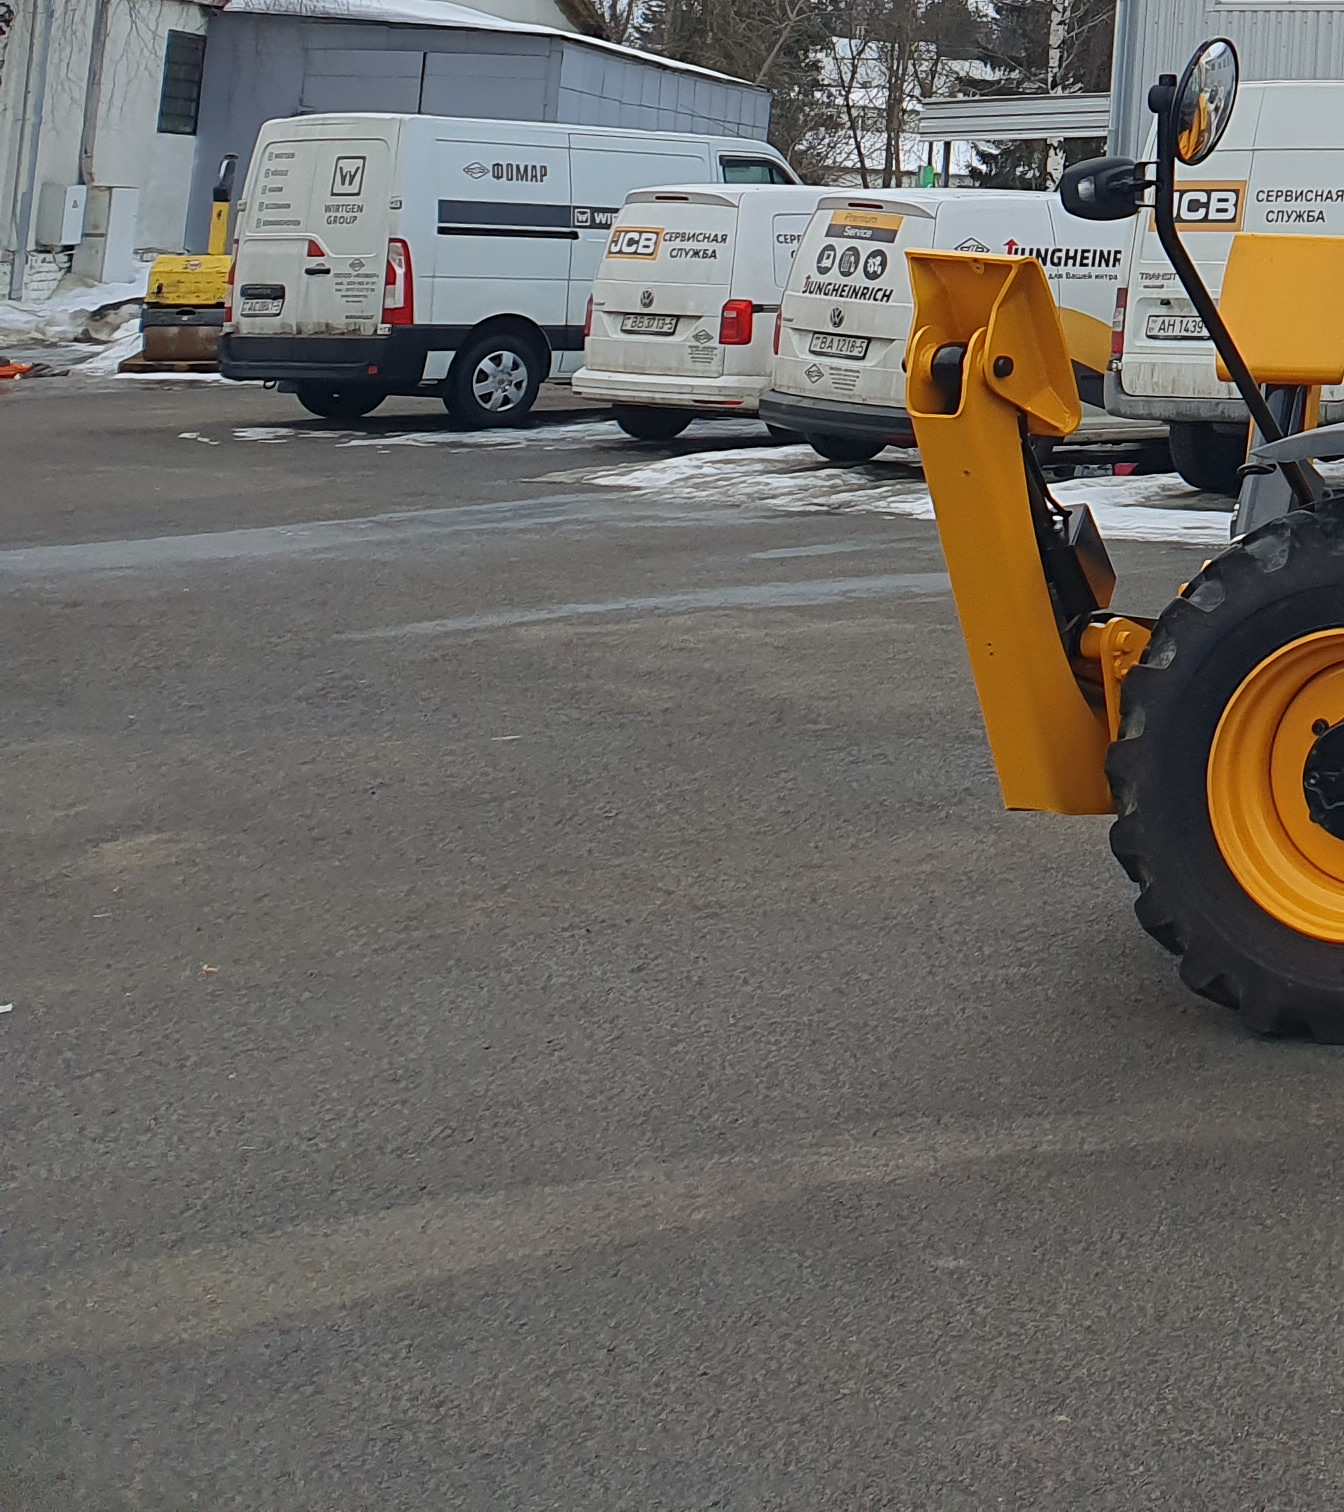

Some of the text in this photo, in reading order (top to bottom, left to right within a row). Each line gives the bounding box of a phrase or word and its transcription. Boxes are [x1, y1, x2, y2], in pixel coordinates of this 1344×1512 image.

[492, 162, 547, 183] ФОМАР
[1256, 189, 1344, 202] СЕРВИСНАЯ
[324, 204, 364, 213] WIRTGEN
[326, 216, 358, 225] GROUP
[1266, 210, 1326, 223] СЛУЖБА
[662, 231, 728, 244] СЕРВИСНАЯ
[843, 226, 872, 238] Service
[610, 232, 657, 254] JCB
[669, 248, 718, 259] СЛУЖБА
[802, 278, 894, 303] JUNGHEINRICH
[1157, 319, 1176, 333] AH
[819, 337, 834, 351] BA
